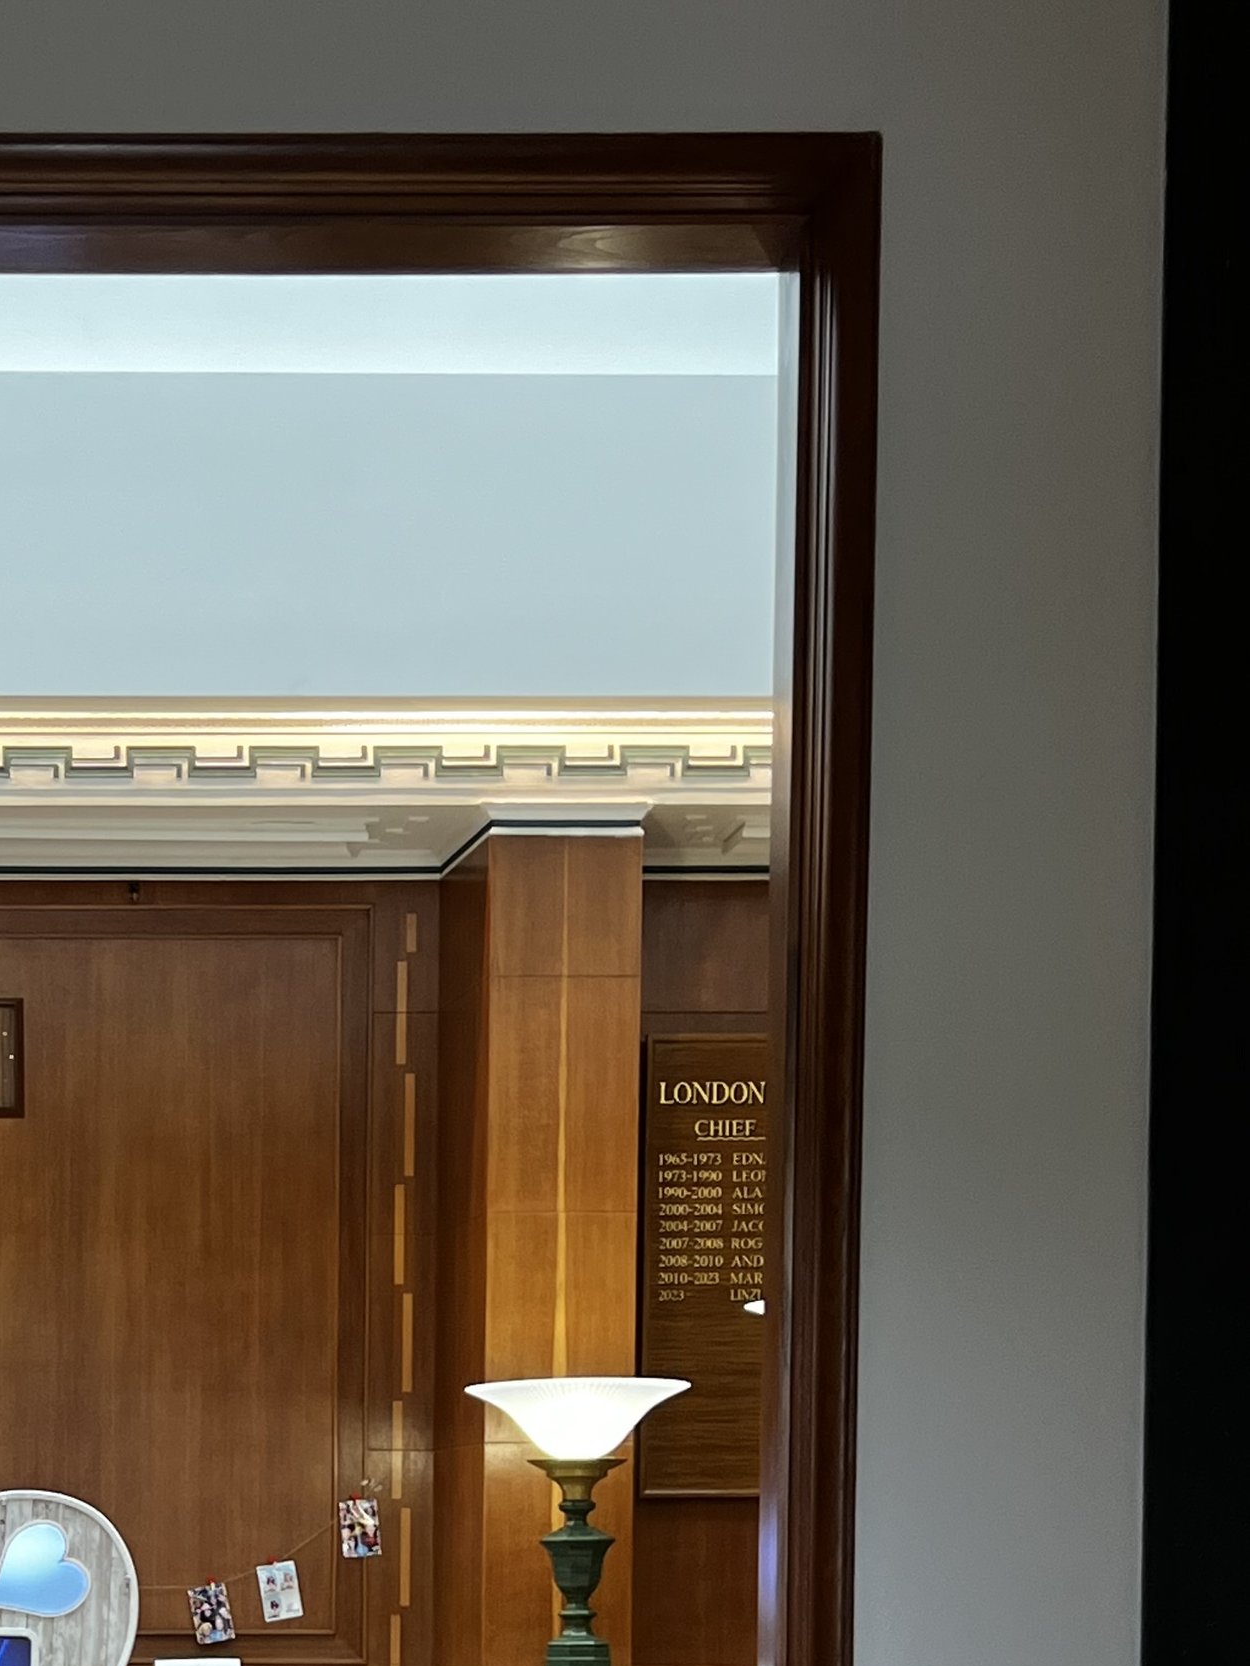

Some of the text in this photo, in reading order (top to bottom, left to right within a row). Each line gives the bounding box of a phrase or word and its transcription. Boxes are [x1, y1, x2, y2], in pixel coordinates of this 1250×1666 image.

[659, 1081, 766, 1104] LONDON
[694, 1119, 757, 1136] CHIEF
[659, 1152, 766, 1166] 1965-1973 EDN
[659, 1170, 723, 1182] 1973-1990
[658, 1186, 722, 1199] 1990-2000
[659, 1203, 723, 1216] 2000-2004
[659, 1220, 723, 1233] 2004-2007
[658, 1237, 763, 1249] 2007-2008 ROG
[658, 1254, 764, 1267] 2008-2010 AND
[658, 1272, 720, 1285] 2010-2023
